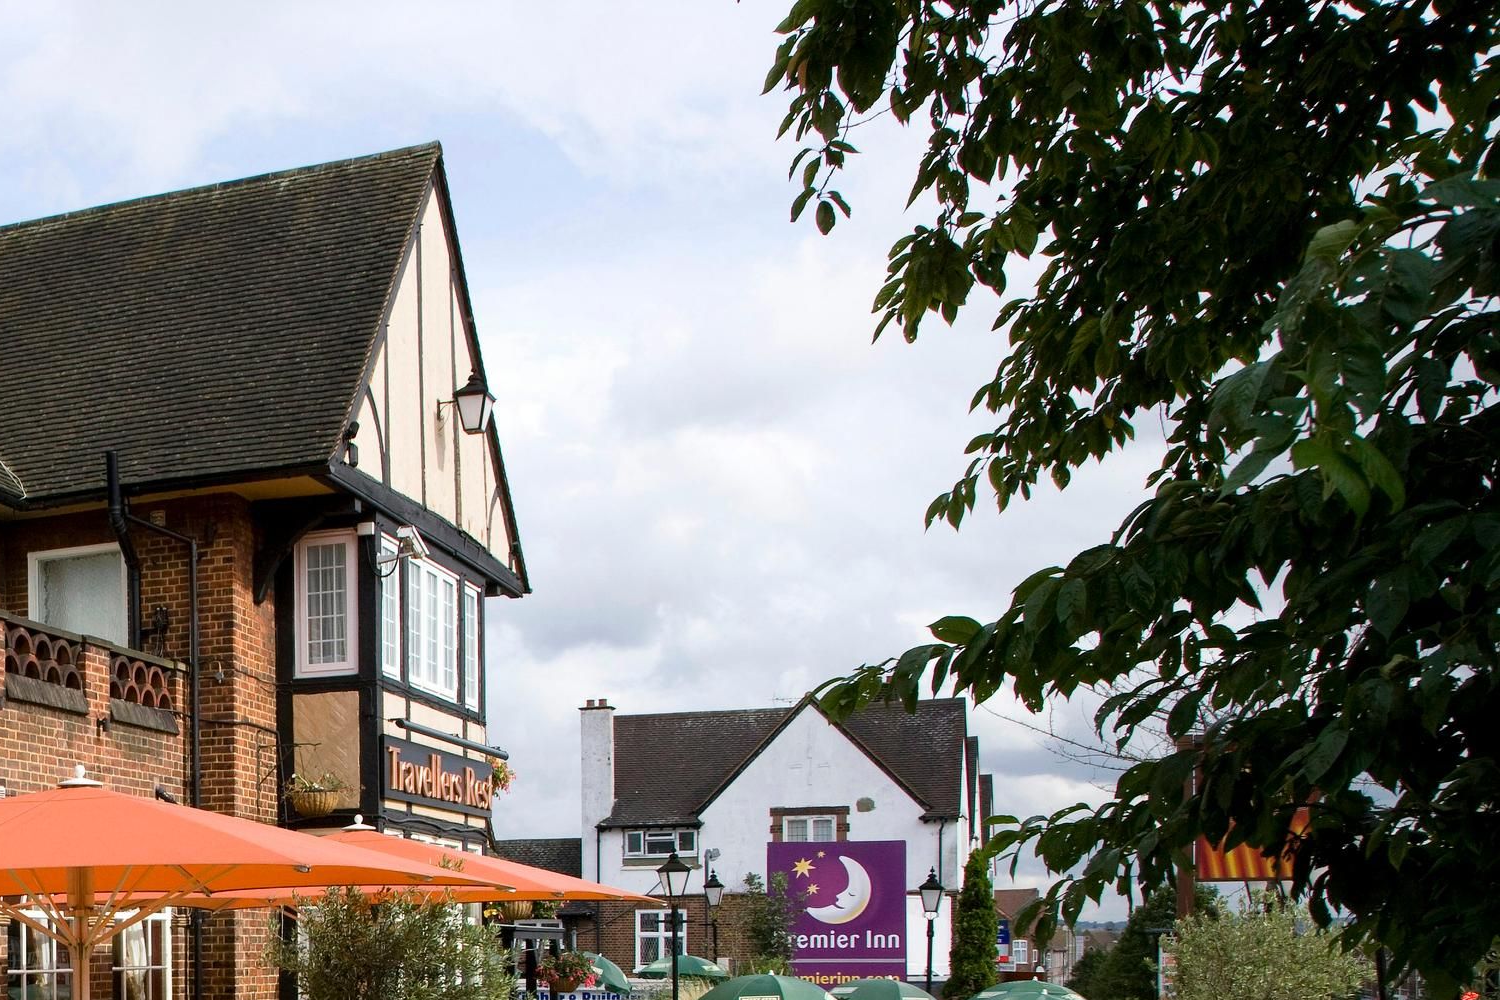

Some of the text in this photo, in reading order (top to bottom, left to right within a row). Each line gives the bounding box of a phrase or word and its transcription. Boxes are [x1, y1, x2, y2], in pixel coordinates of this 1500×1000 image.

[388, 746, 492, 810] Travellers Rest
[787, 930, 899, 948] remier Inn
